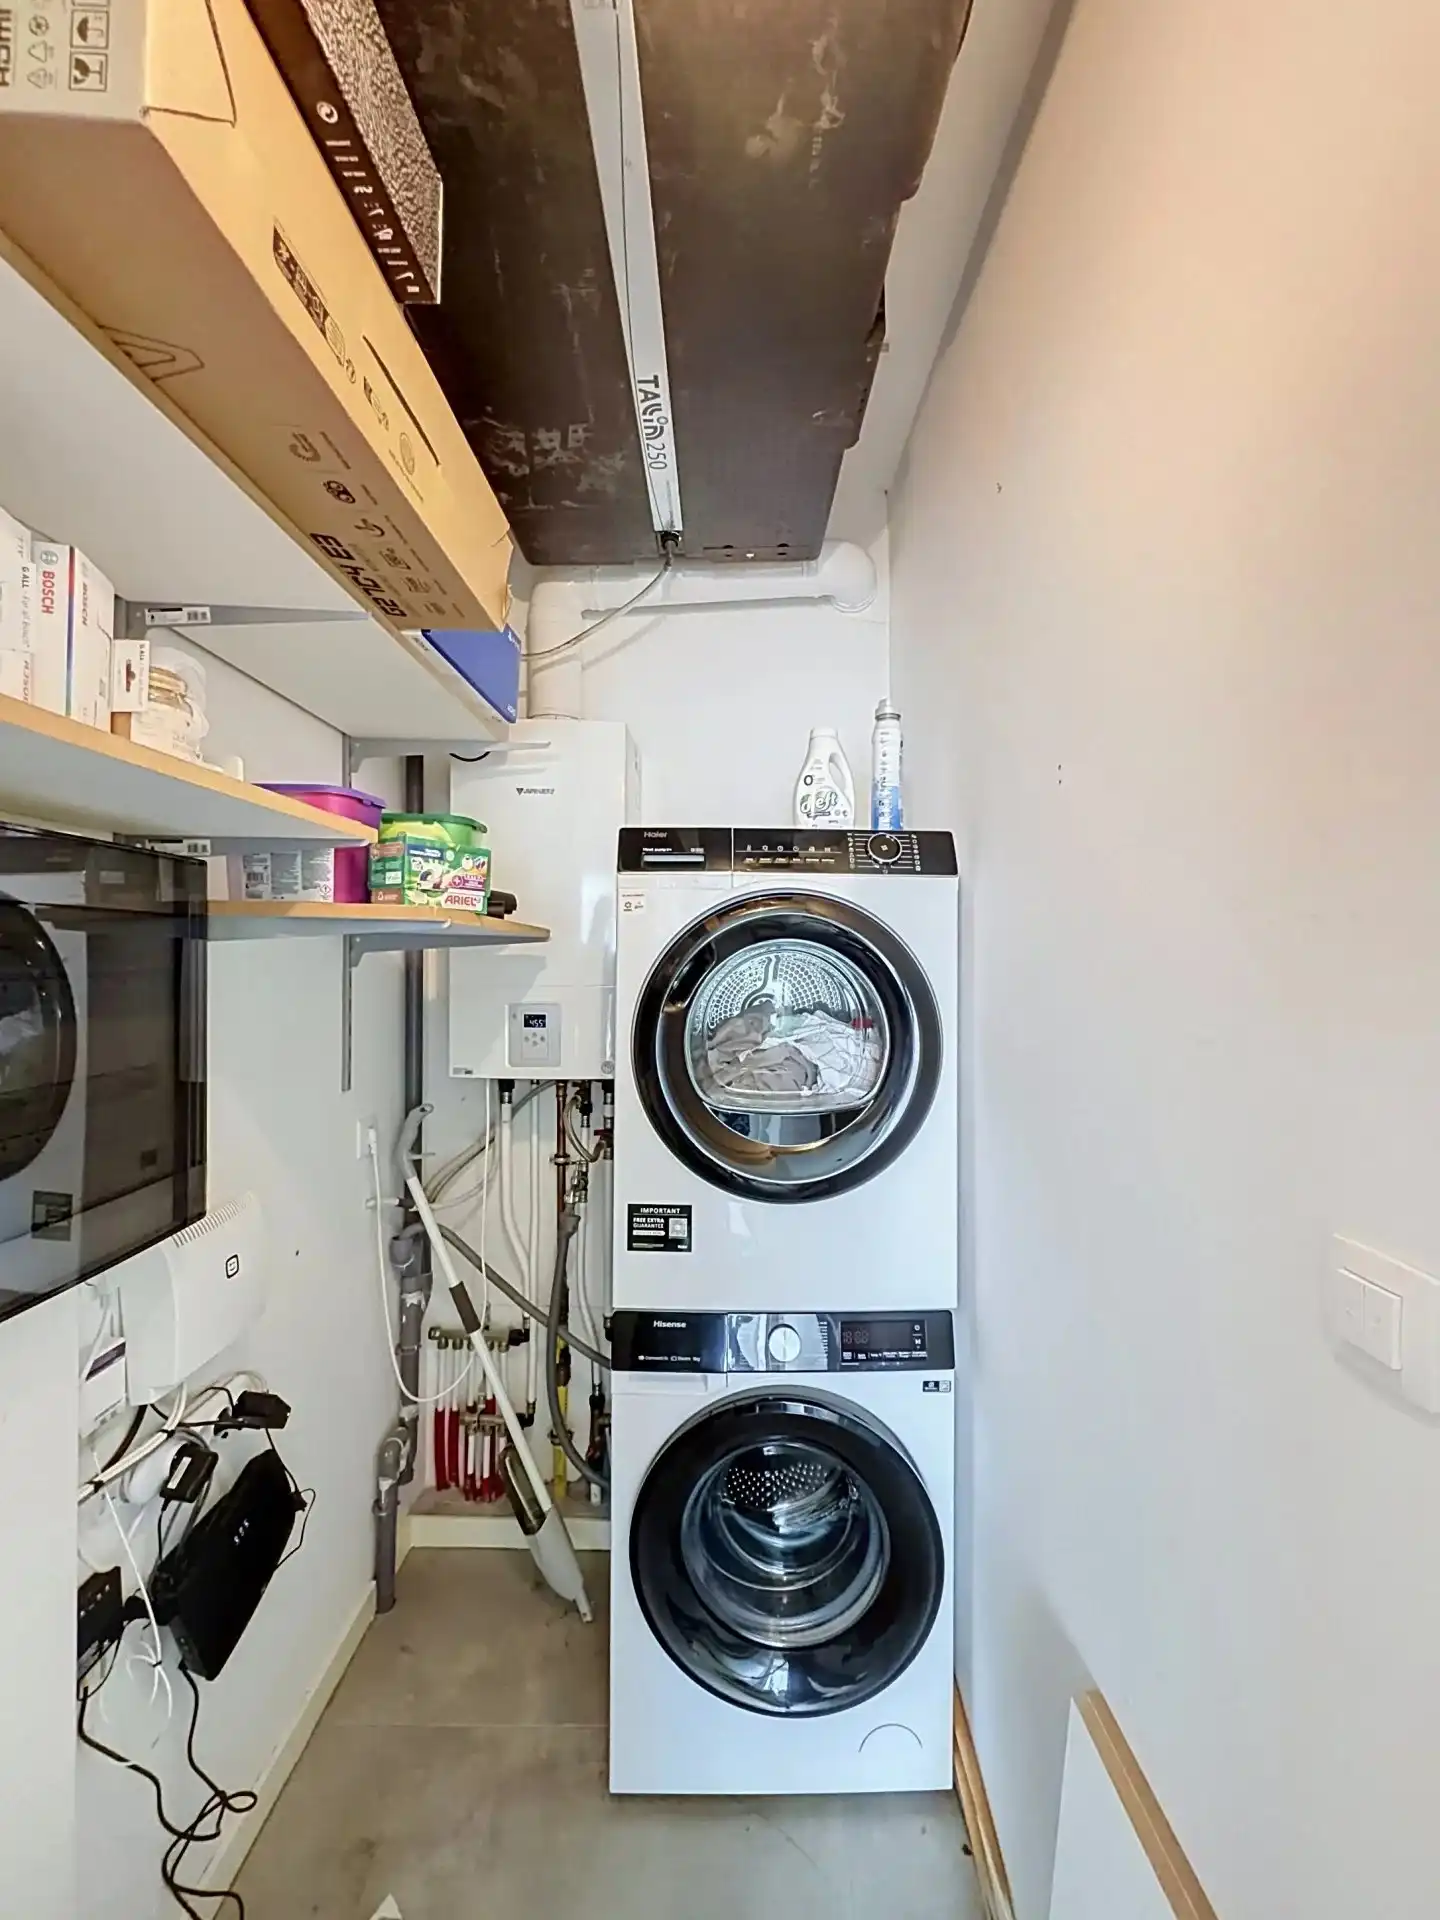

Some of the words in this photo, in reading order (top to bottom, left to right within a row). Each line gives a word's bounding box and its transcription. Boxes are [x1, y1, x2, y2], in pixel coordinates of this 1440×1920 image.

[645, 443, 668, 470] 250
[309, 534, 355, 559] E3
[21, 573, 30, 588] ALL
[41, 570, 56, 615] BOSCH
[643, 831, 668, 839] Haier
[444, 894, 477, 907] ARIEL
[640, 1207, 681, 1215] IMPORTANT
[653, 1320, 687, 1329] Hisense
